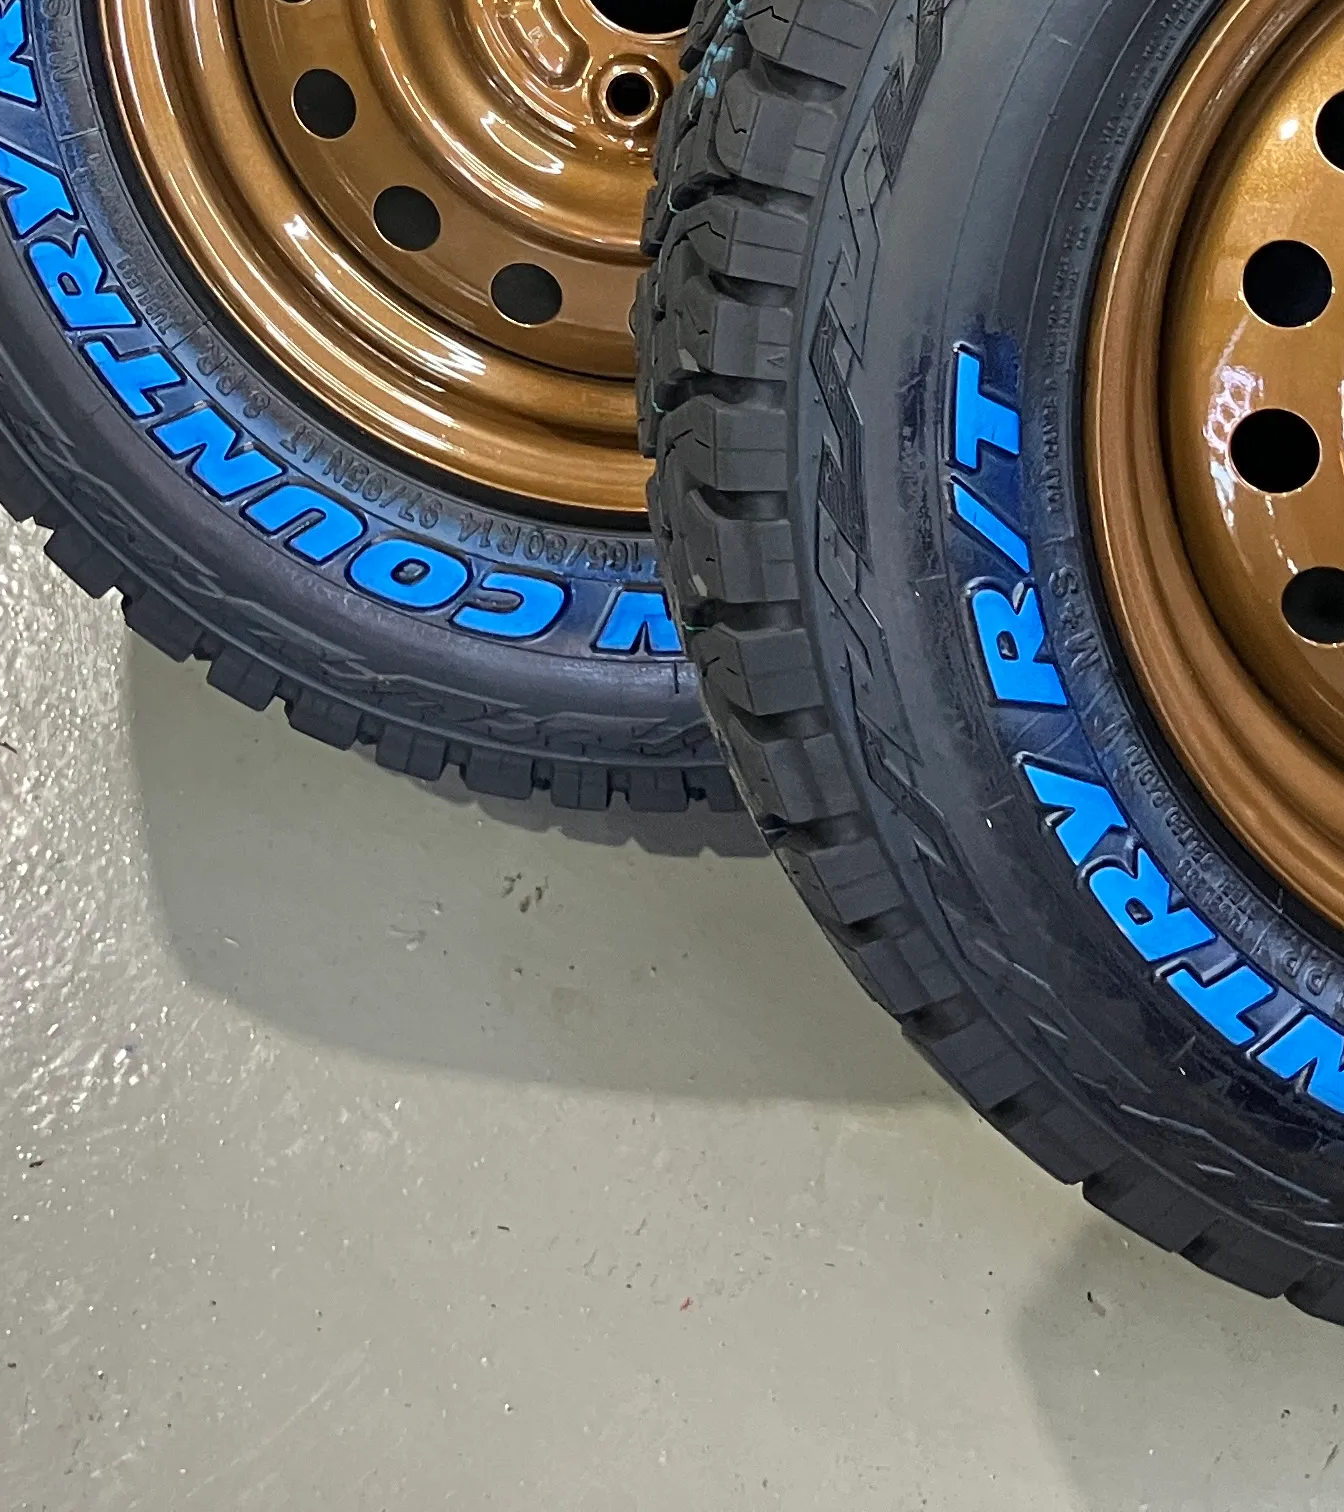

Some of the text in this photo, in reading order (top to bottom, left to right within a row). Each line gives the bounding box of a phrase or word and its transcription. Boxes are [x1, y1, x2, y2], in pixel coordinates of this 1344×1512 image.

[275, 419, 326, 467] LT
[317, 447, 447, 533] 97/95N
[952, 350, 1071, 709] R/T
[454, 506, 642, 577] 165/80R14
[1040, 561, 1108, 676] M+S
